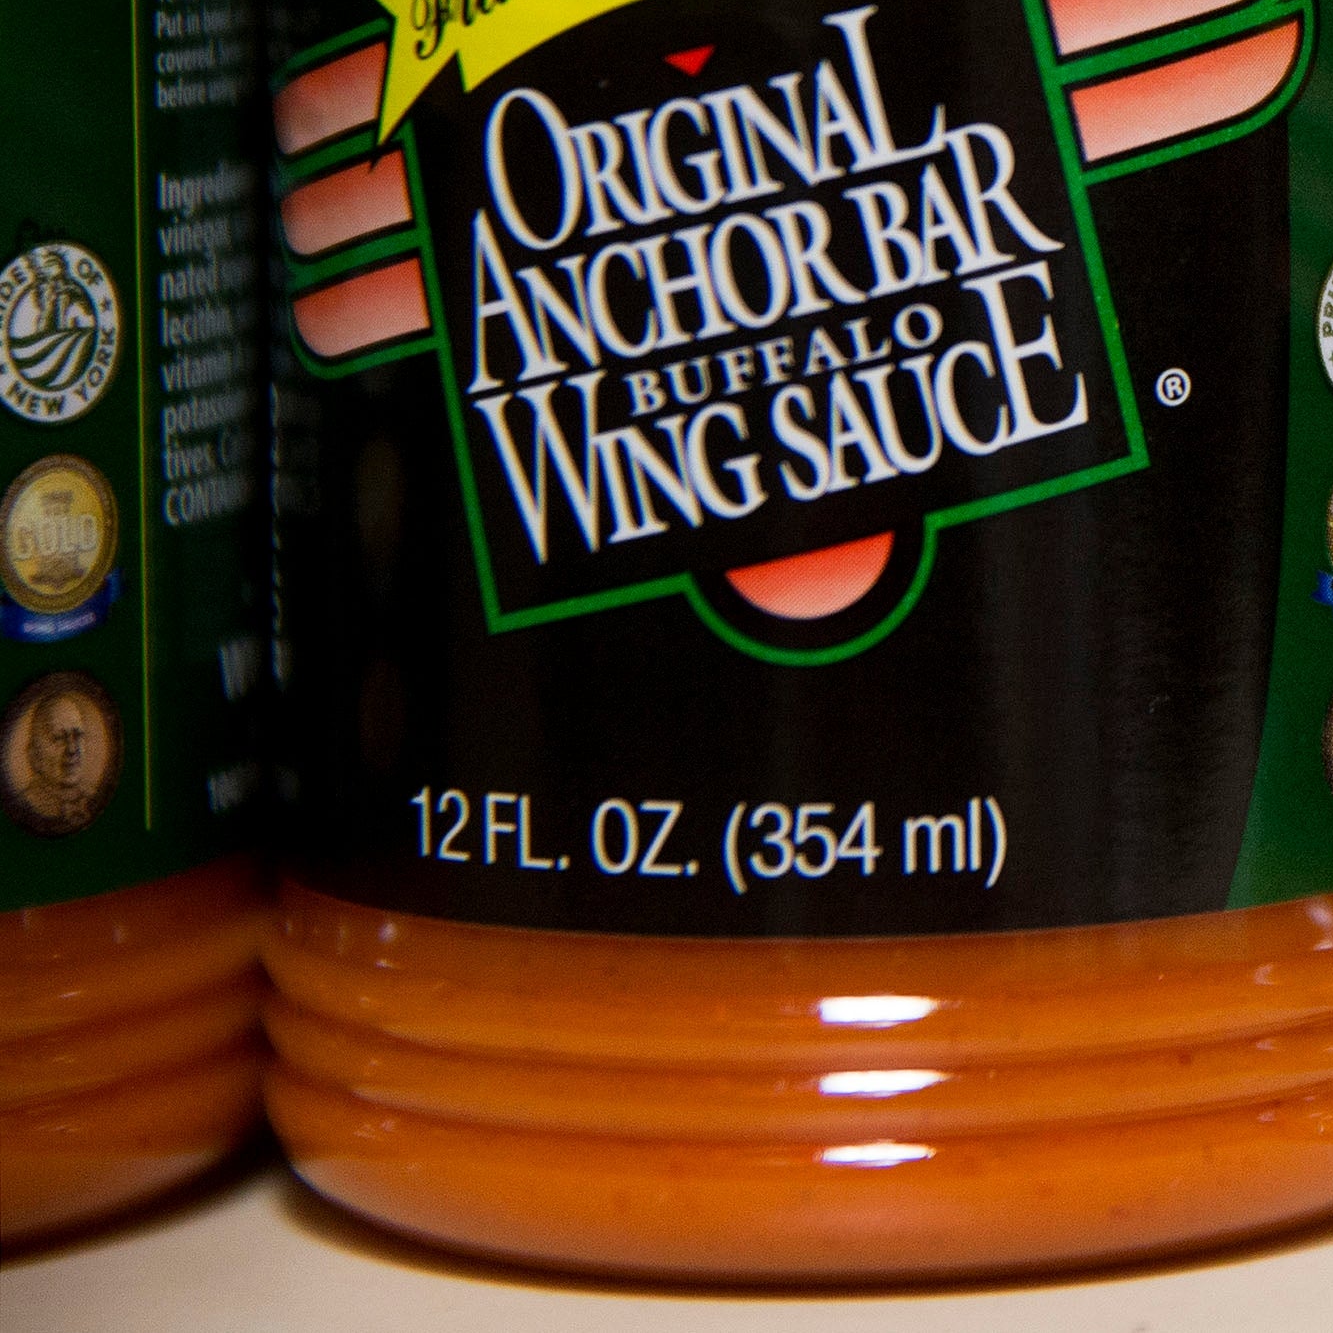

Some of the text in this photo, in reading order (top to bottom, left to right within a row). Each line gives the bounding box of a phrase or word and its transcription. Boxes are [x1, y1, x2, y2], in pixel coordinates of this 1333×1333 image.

[484, 5, 946, 252] ORIGINAL
[467, 122, 1066, 394] ANCHOR BAR
[6, 326, 116, 416] NEW YORK
[474, 370, 768, 564] WING
[771, 261, 1089, 502] SAUCE
[622, 302, 943, 417] BUFFALO
[410, 786, 1007, 895] 12 FL. OZ. (354 ml)
